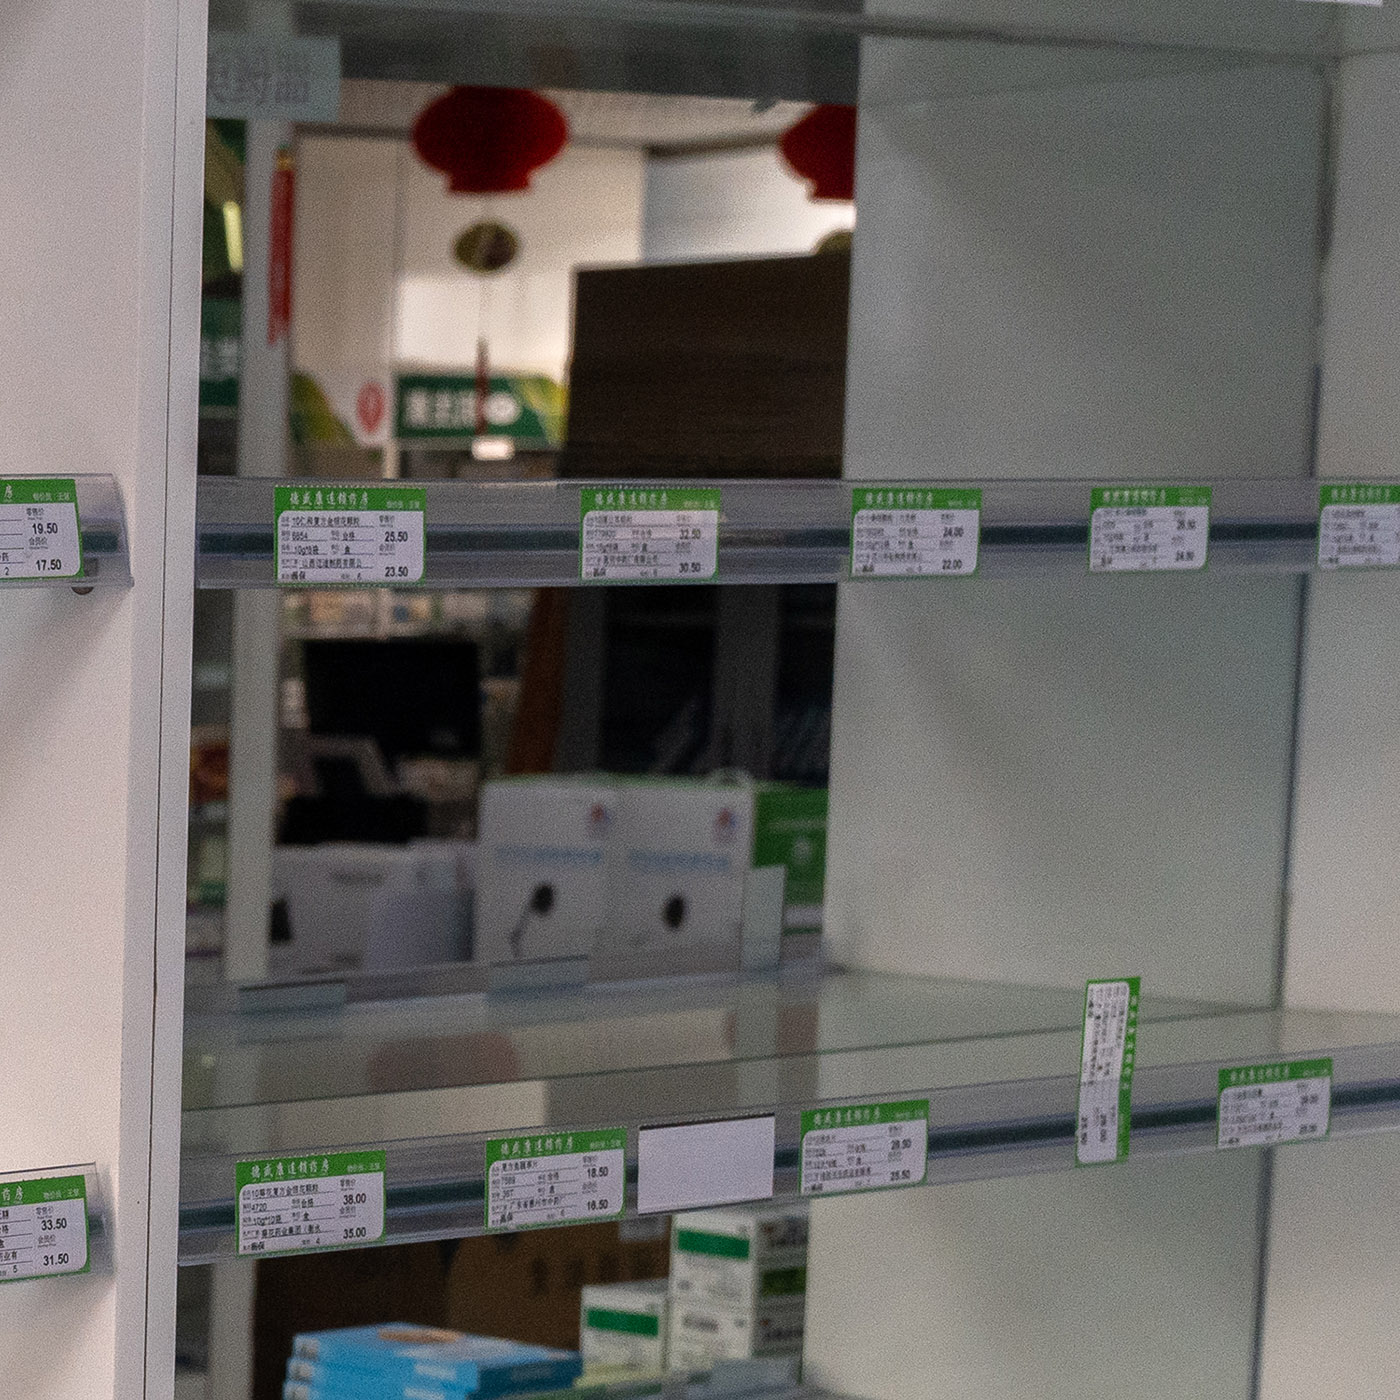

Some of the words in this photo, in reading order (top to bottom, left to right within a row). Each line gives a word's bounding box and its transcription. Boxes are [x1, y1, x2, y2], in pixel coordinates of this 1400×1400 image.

[32, 523, 58, 534] 19.50
[385, 531, 408, 542] 25.50
[36, 559, 61, 570] 17.50
[385, 566, 408, 577] 23.50
[343, 1193, 366, 1205] 38.00
[41, 1218, 67, 1231] 33.50
[343, 1227, 366, 1239] 35.00
[43, 1253, 69, 1266] 31.50
